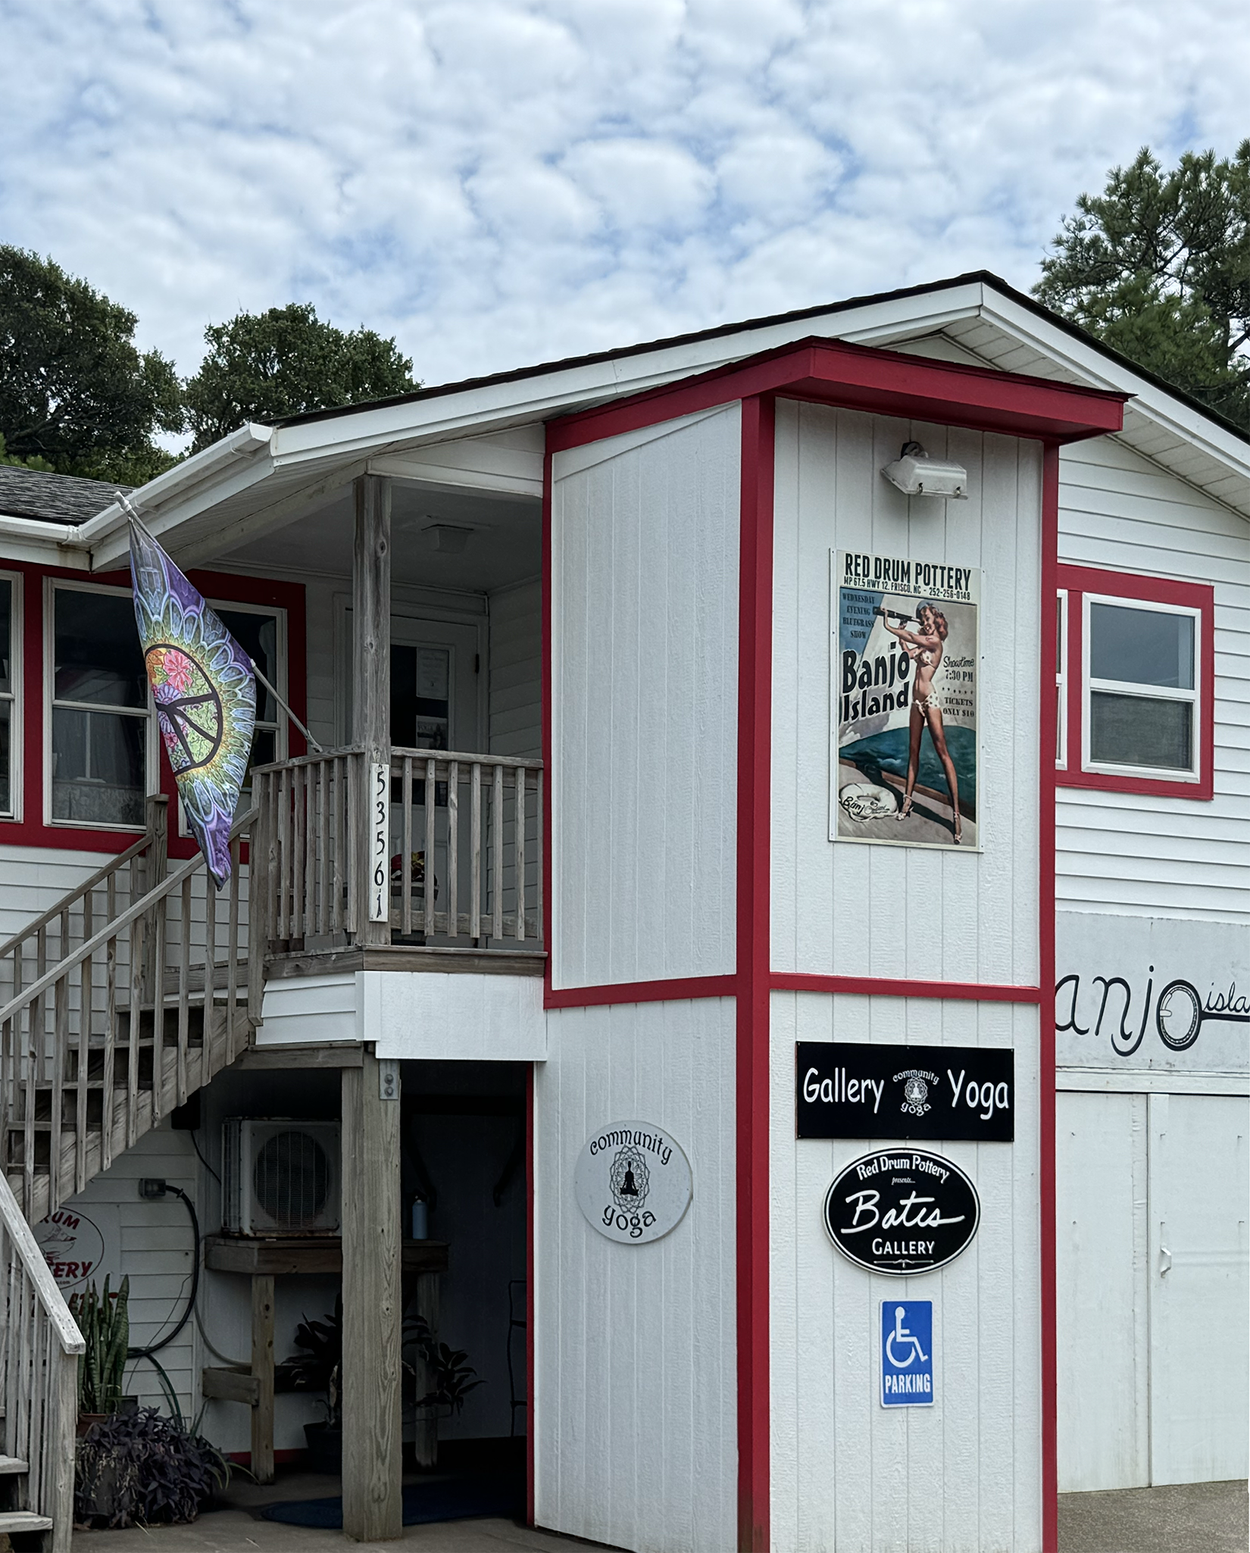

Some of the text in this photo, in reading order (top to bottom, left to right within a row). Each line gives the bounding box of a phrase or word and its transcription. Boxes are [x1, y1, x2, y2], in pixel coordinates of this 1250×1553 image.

[845, 553, 971, 592] RED DRUM POTTERY
[867, 579, 880, 589] HWY
[913, 585, 921, 594] NC
[842, 593, 875, 604] WEDNESDAY
[846, 605, 871, 616] EVENING
[842, 641, 910, 694] Banjo
[945, 669, 974, 682] 7:30 PM
[843, 681, 910, 722] Island
[944, 696, 974, 707] TICKETS
[942, 707, 975, 718] ONLY $10
[1055, 965, 1250, 1057] anjo isla
[892, 1069, 940, 1085] community
[803, 1067, 1010, 1120] Gallery Yoga
[900, 1102, 932, 1117] yoga
[590, 1129, 673, 1166] community
[856, 1154, 950, 1184] Red Drum Pottery
[602, 1205, 657, 1239] yoga
[841, 1190, 966, 1234] Bates
[872, 1238, 935, 1256] GALLERY
[885, 1374, 931, 1394] PARKING
